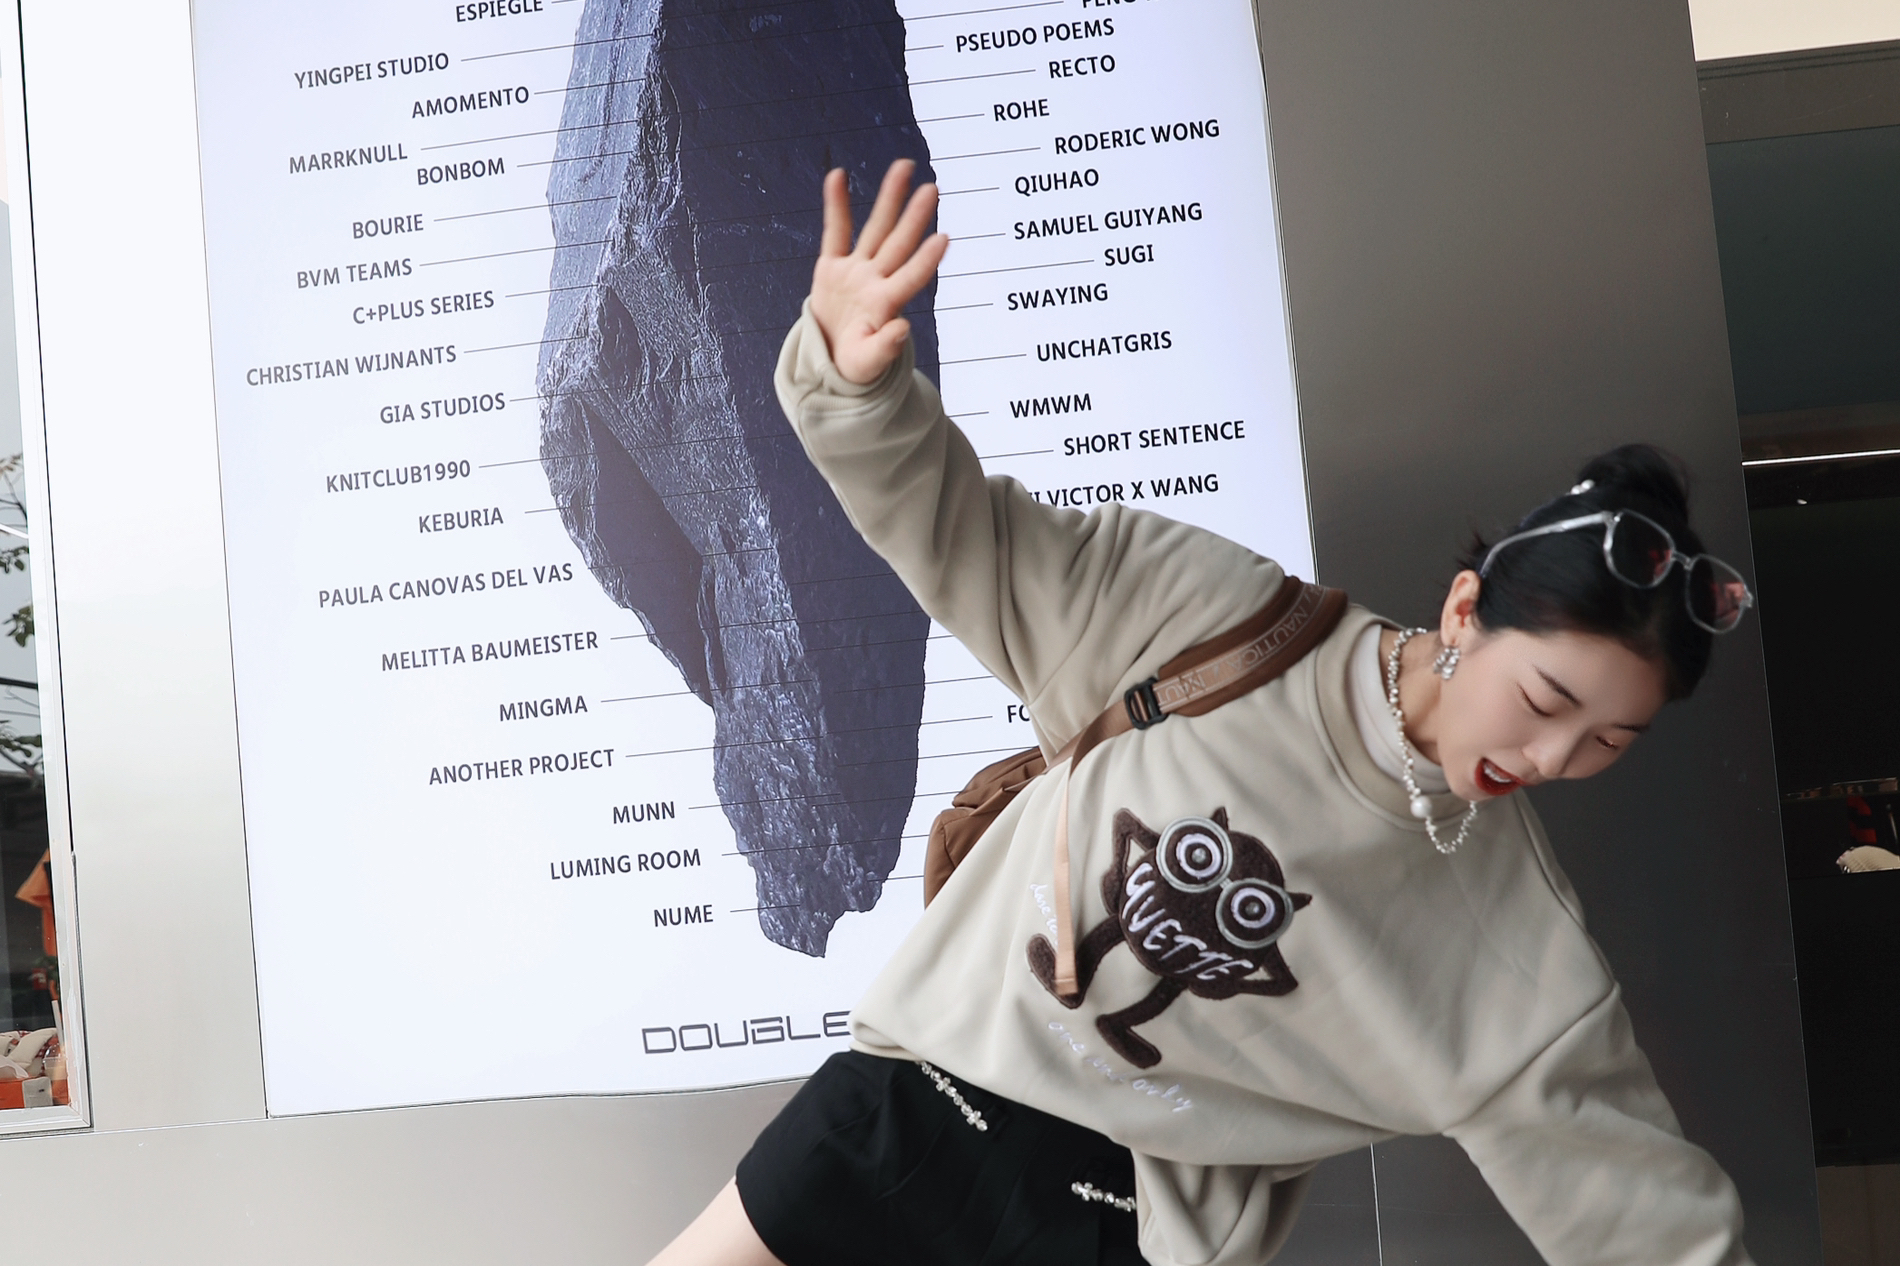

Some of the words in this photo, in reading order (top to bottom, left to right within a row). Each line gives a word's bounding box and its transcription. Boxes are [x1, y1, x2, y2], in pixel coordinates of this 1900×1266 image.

[455, 0, 544, 23] ESPIEGLE
[956, 27, 1037, 53] PSEUDO
[1043, 17, 1115, 43] POEMS
[294, 62, 372, 89] YINGPEI
[377, 52, 449, 79] STUDIO
[1048, 54, 1116, 79] RECTO
[412, 86, 529, 119] AMOMENTO
[993, 98, 1050, 122] ROHE
[1054, 127, 1146, 155] RODERIC
[1150, 119, 1220, 144] WONG
[289, 143, 408, 174] MARRKNULL
[417, 157, 505, 186] BONBOM
[1014, 168, 1099, 197] QIUHAO
[352, 213, 424, 240] BOURIE
[1014, 214, 1099, 240] SAMUEL
[1104, 202, 1203, 230] GUIYANG
[1104, 244, 1155, 267] SUGI
[297, 267, 340, 289] BVM
[345, 258, 413, 283] TEAMS
[353, 299, 425, 325] C+PLUS
[430, 290, 495, 315] SERIES
[1007, 282, 1108, 311] SWAYING
[1036, 330, 1172, 362] UNCHATGRIS
[246, 357, 349, 386] CHRISTIAN
[354, 344, 457, 374] WIJNANTS
[380, 403, 415, 424] GIA
[420, 392, 506, 420] STUDIOS
[1009, 393, 1092, 419] WMWM
[1063, 431, 1132, 456] SHORT
[1138, 420, 1246, 449] SENTENCE
[326, 459, 471, 493] KNITCLUB1990
[1047, 484, 1125, 507] VICTOR
[1130, 480, 1145, 500] X
[1150, 473, 1219, 498] WANG
[418, 507, 504, 534] KEBURIA
[319, 584, 384, 609] PAULA
[389, 572, 486, 601] CANOVAS
[491, 568, 528, 590] DEL
[532, 562, 573, 584] VAS
[382, 645, 466, 672] MELITTA
[471, 631, 599, 662] BAUMEISTER
[1227, 604, 1309, 677] NAUTICA
[499, 695, 588, 722] MINGMA
[429, 758, 524, 786] ANOTHER
[529, 748, 615, 775] PROJECT
[613, 801, 675, 825] MUNN
[550, 854, 631, 880] LUMING
[637, 848, 701, 872] ROOM
[653, 904, 714, 928] NUME
[642, 1010, 852, 1054] DOUBLE
